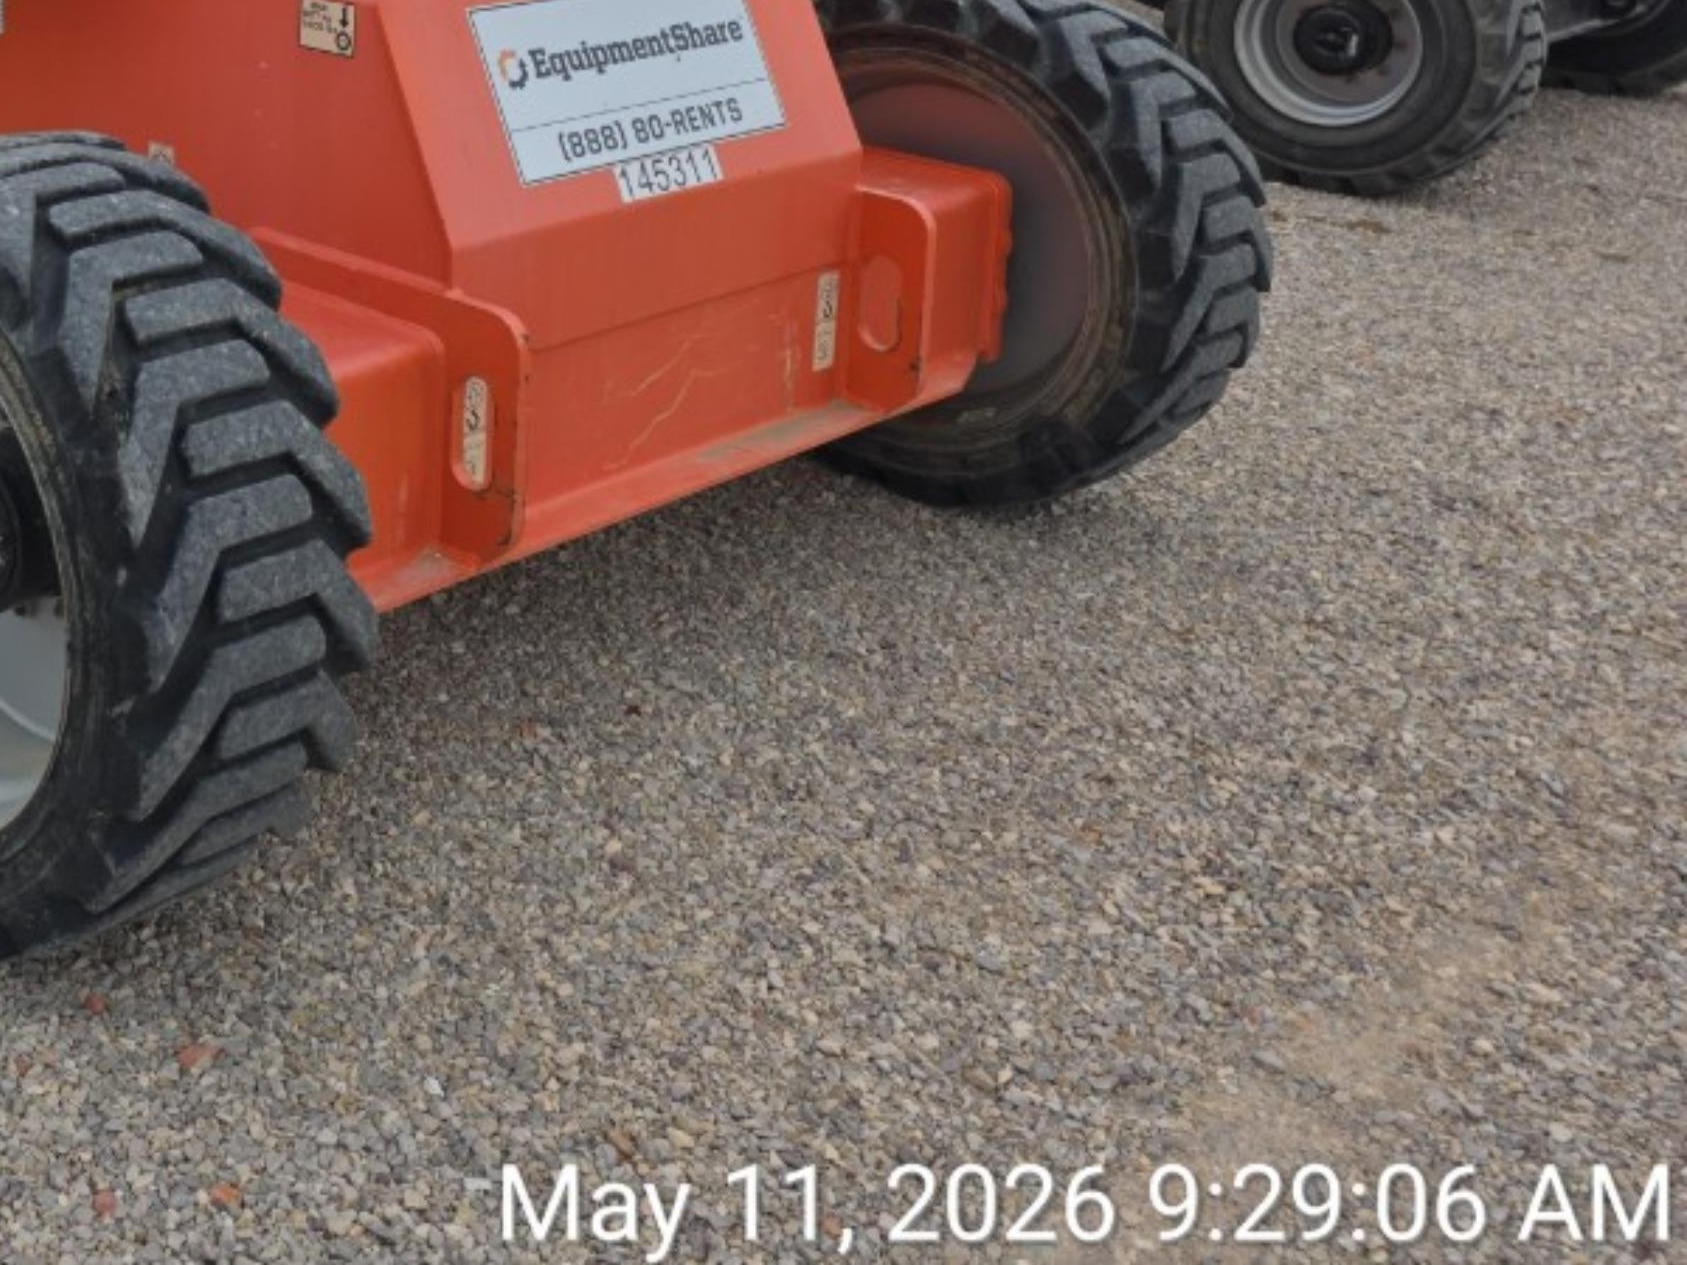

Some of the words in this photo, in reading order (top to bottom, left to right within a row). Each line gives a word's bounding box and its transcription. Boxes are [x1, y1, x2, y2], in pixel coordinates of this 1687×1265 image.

[528, 19, 743, 81] EquipmentShare
[558, 121, 627, 163] (888)
[634, 97, 743, 145] 80-RENTS
[618, 147, 719, 198] 145311
